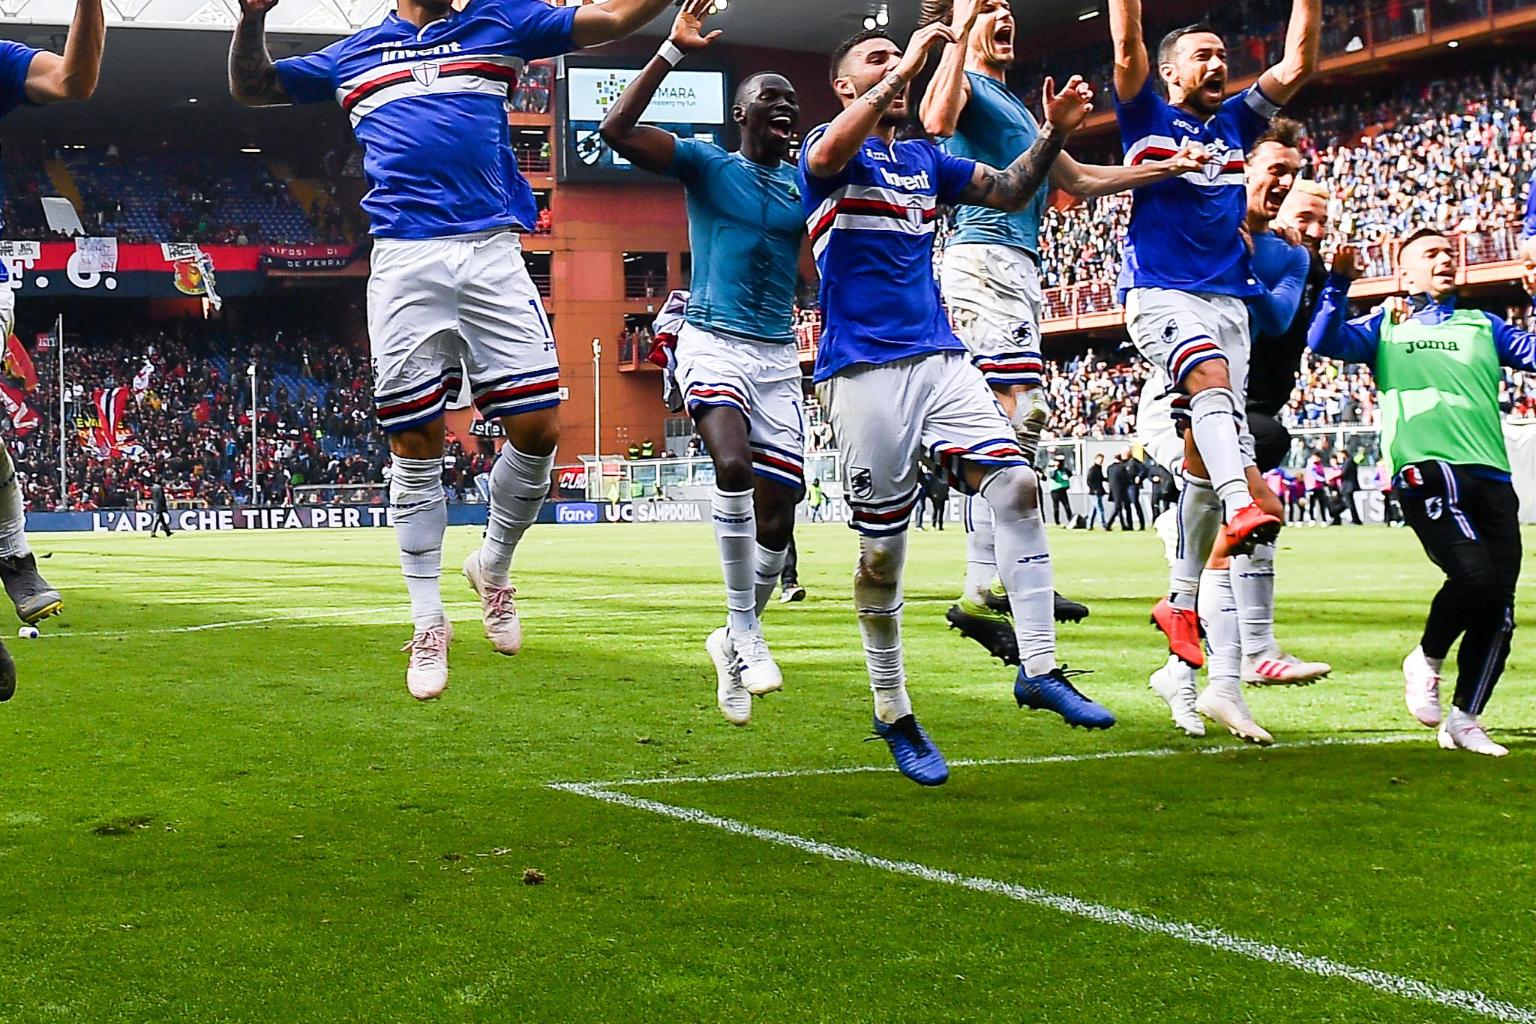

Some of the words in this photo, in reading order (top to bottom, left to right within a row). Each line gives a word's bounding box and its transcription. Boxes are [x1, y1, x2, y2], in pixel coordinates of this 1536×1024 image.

[654, 87, 696, 98] MARA
[1406, 340, 1460, 354] Joma
[179, 509, 234, 531] CHE
[242, 508, 304, 529] TIFA
[312, 507, 361, 528] PER
[605, 504, 633, 522] UC
[637, 503, 702, 522] SAMPDORIA
